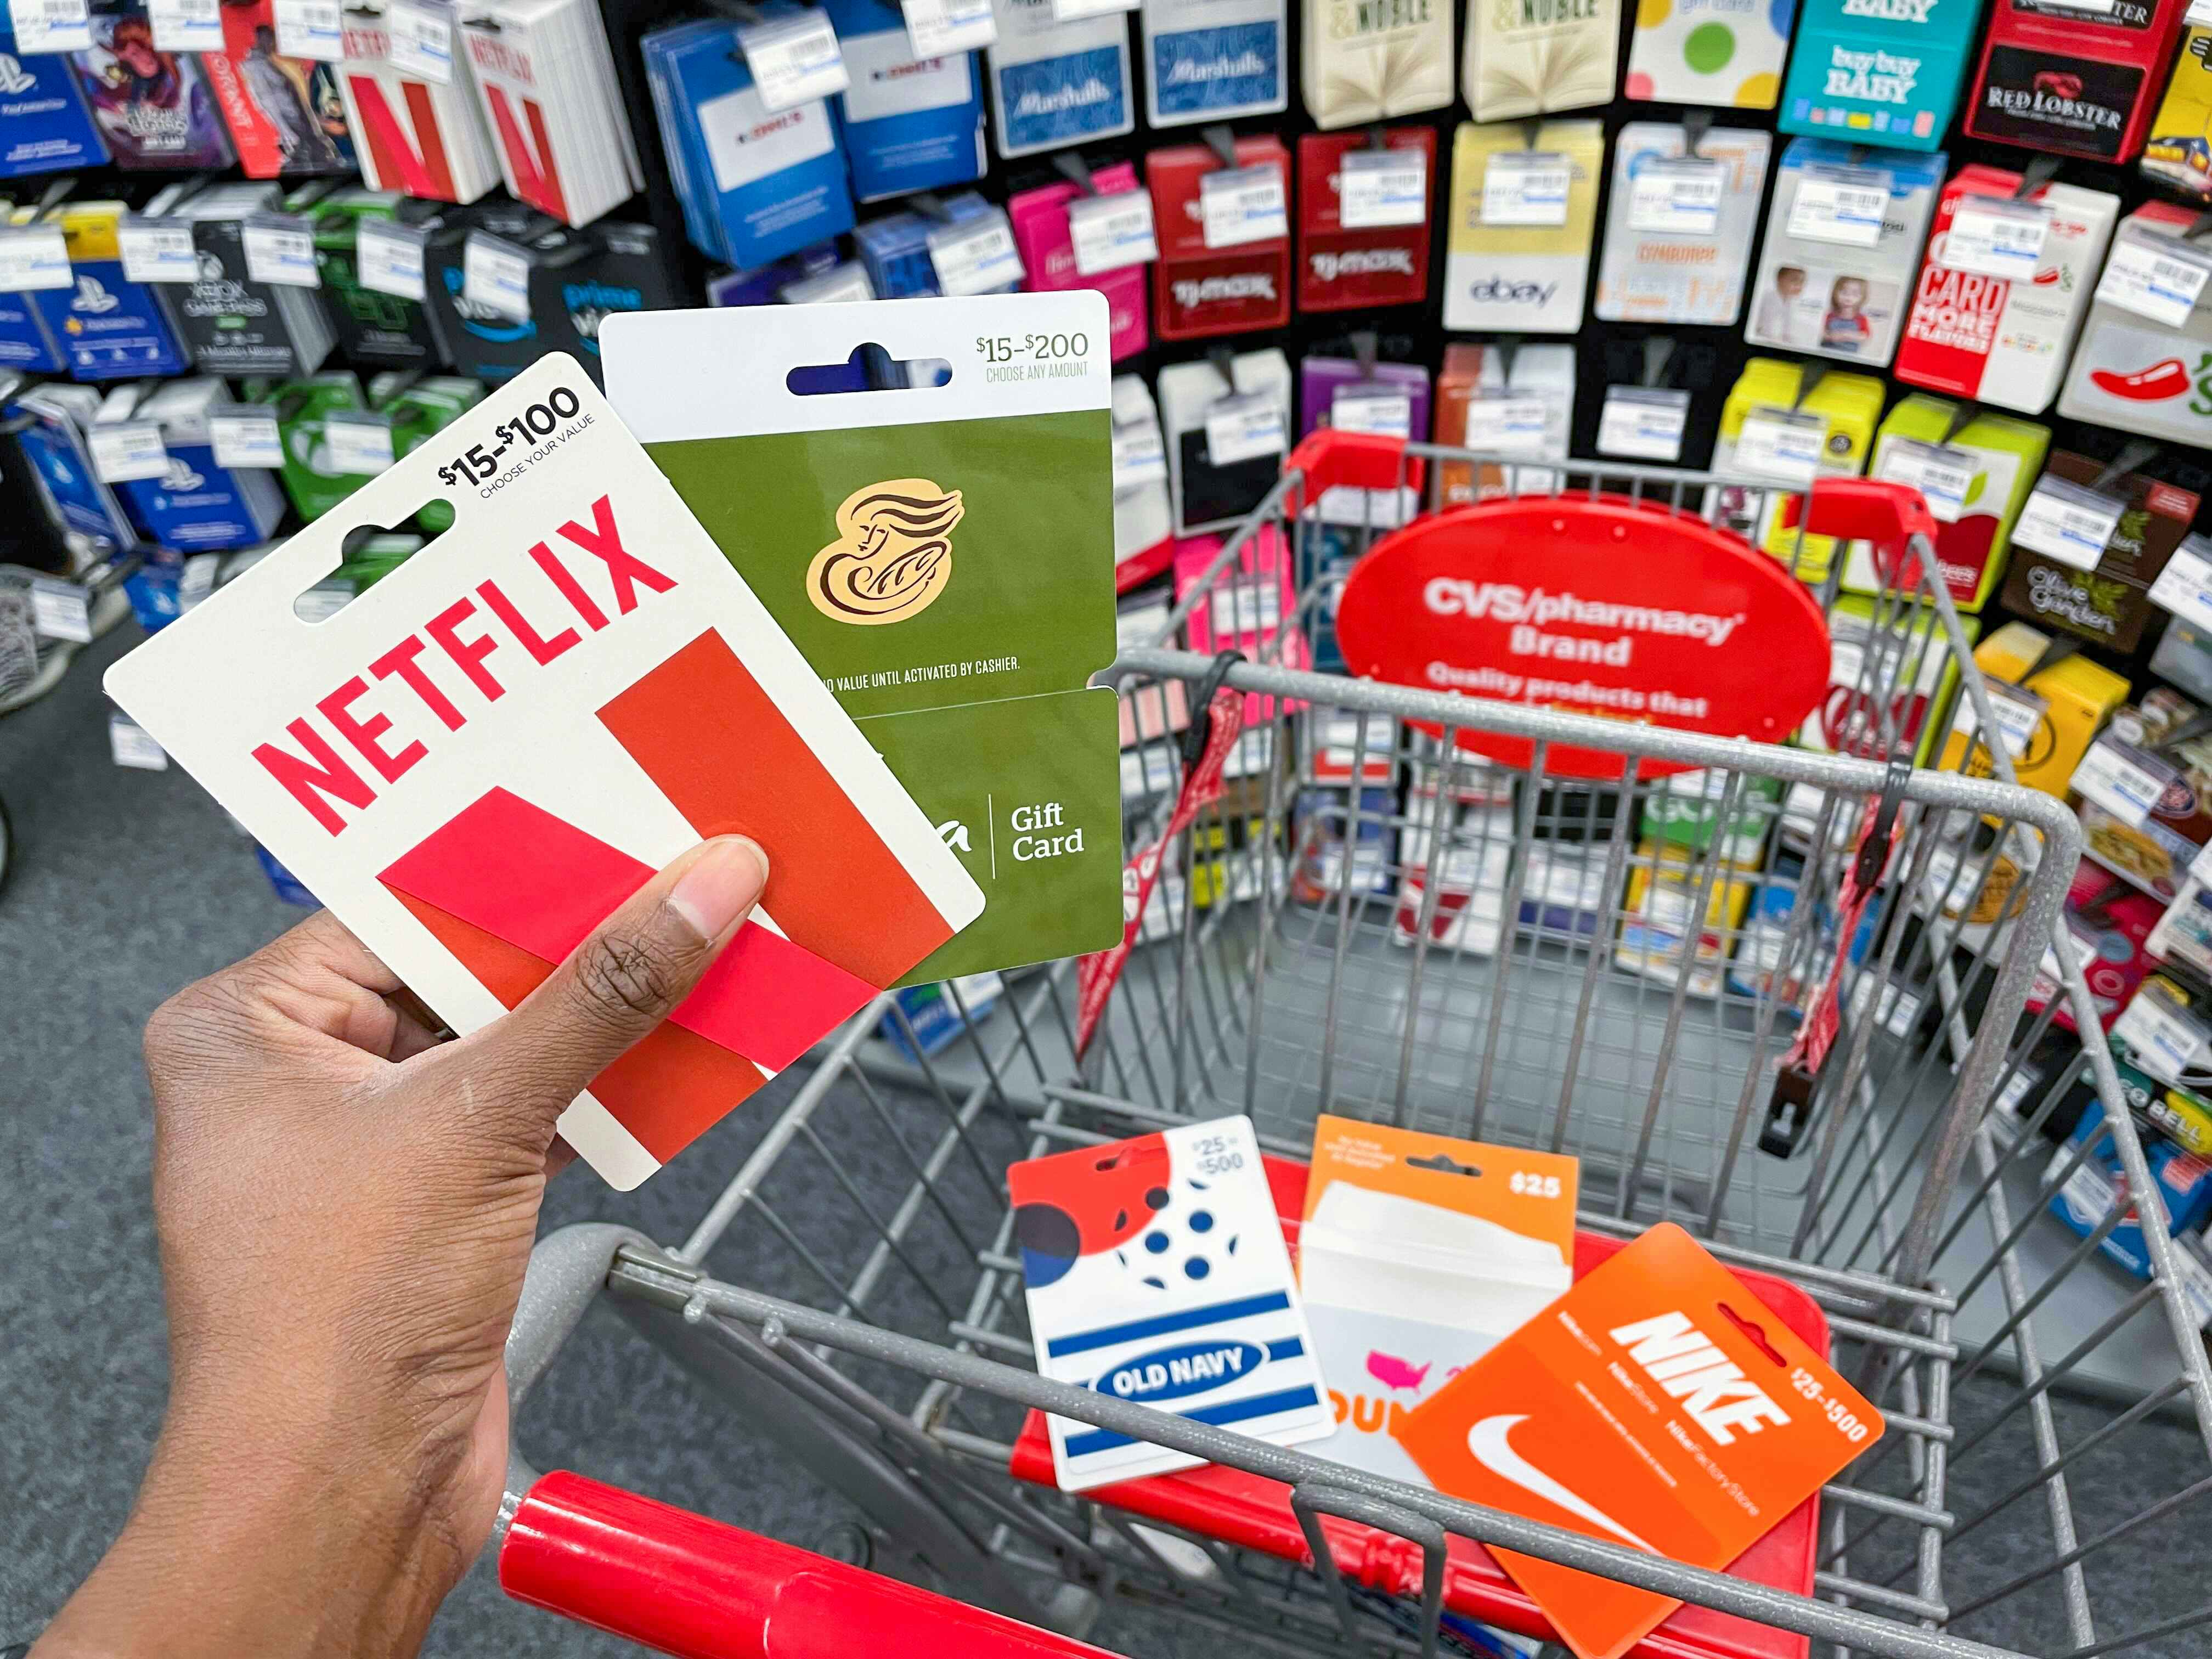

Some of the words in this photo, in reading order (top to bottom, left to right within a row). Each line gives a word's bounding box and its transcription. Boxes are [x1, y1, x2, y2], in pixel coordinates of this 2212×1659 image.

[1823, 69, 1917, 104] BABY
[1987, 86, 2031, 110] RED
[2033, 90, 2122, 131] LOBSTER
[1469, 274, 1559, 310] ebay
[1919, 262, 2008, 317] CARD
[977, 332, 1088, 362] $15-$200
[987, 365, 1024, 382] CHOOSE
[1028, 364, 1046, 380] ANY
[1048, 361, 1088, 378] AMOUNT
[438, 387, 580, 487] $15-$100
[481, 462, 527, 498] CHOOSE
[524, 441, 558, 466] YOUR
[556, 414, 595, 443] VALUE
[1423, 577, 1740, 646] CVS/pharmacy
[251, 493, 679, 838] NETFLIX
[1509, 624, 1633, 668] Brand
[837, 674, 869, 691] VALUE
[872, 670, 901, 687] UNTIL
[905, 664, 957, 683] ACTIVATED
[960, 662, 973, 676] BY
[975, 656, 1020, 674] CASHIER.
[1427, 661, 1522, 697] Quality
[1525, 676, 1645, 710] products
[1649, 690, 1708, 719] that
[1011, 802, 1064, 832] Gift
[1012, 828, 1085, 861] Card
[1509, 1170, 1561, 1199] $25
[1111, 1364, 1168, 1396] OLD
[1174, 1347, 1244, 1384] NAVY
[1608, 1310, 1793, 1447] NIKE
[1790, 1368, 1868, 1443] $25-$500
